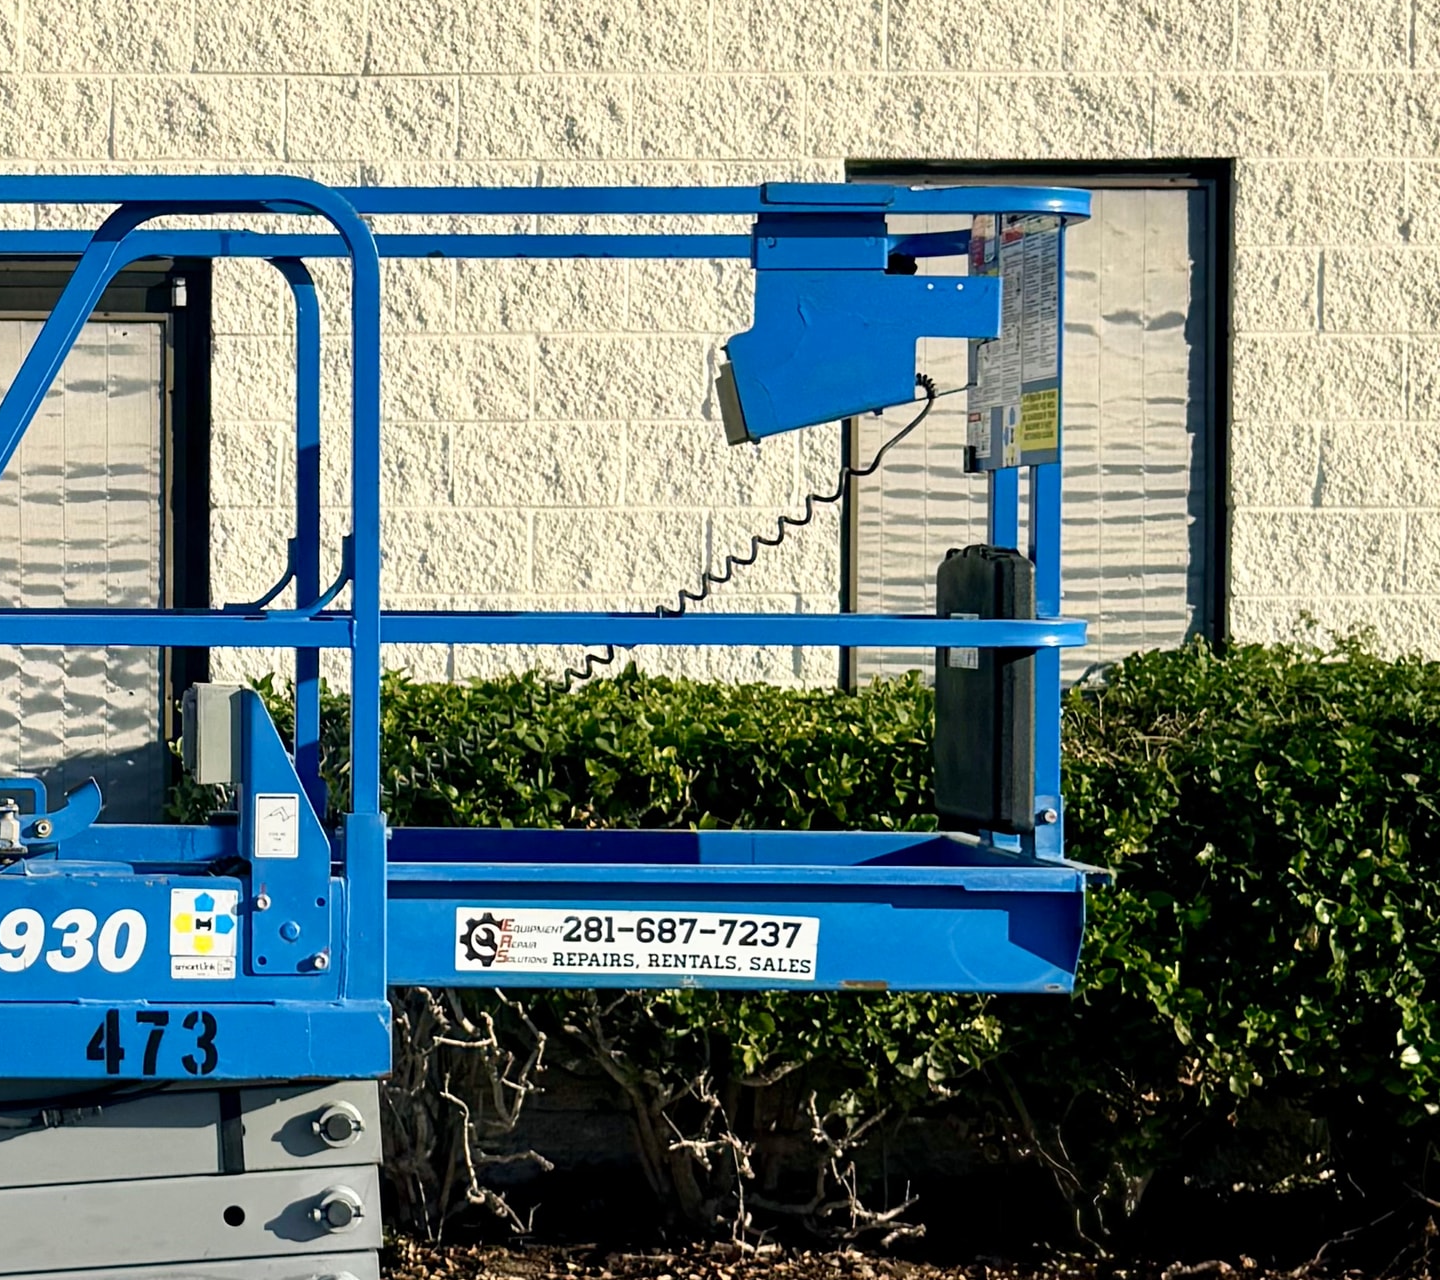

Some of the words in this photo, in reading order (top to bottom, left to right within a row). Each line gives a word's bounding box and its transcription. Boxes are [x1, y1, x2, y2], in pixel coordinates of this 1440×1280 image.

[563, 915, 803, 949] 281-687-7237
[552, 951, 640, 969] REPAIRS,
[647, 953, 742, 972] RENTALS,
[749, 957, 812, 974] SALES
[85, 1008, 219, 1076] 473
